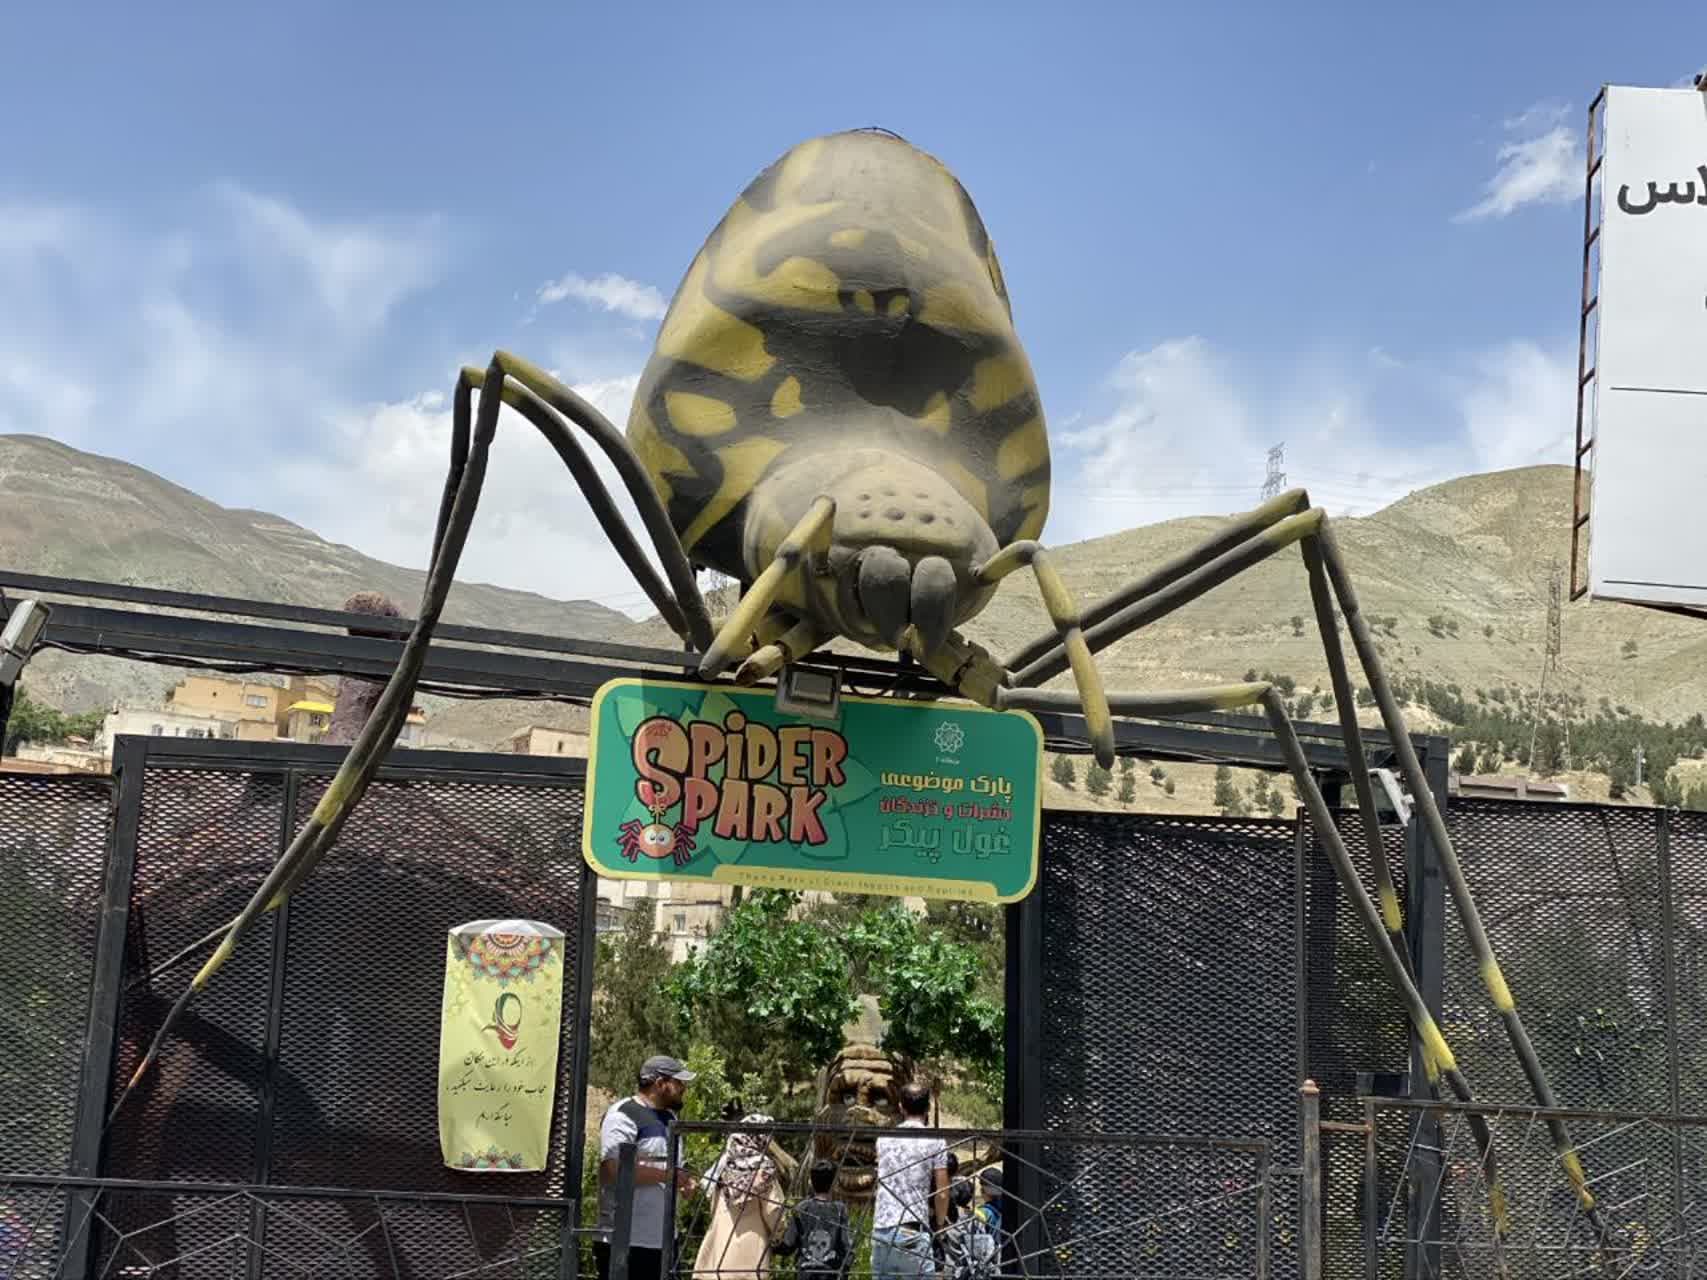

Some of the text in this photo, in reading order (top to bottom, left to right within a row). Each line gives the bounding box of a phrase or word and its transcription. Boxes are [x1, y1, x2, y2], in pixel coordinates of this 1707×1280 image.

[880, 771, 1012, 803] پارک موضوعی
[682, 777, 828, 846] PARK
[943, 805, 954, 821] و
[880, 820, 1011, 863] غول پیکر
